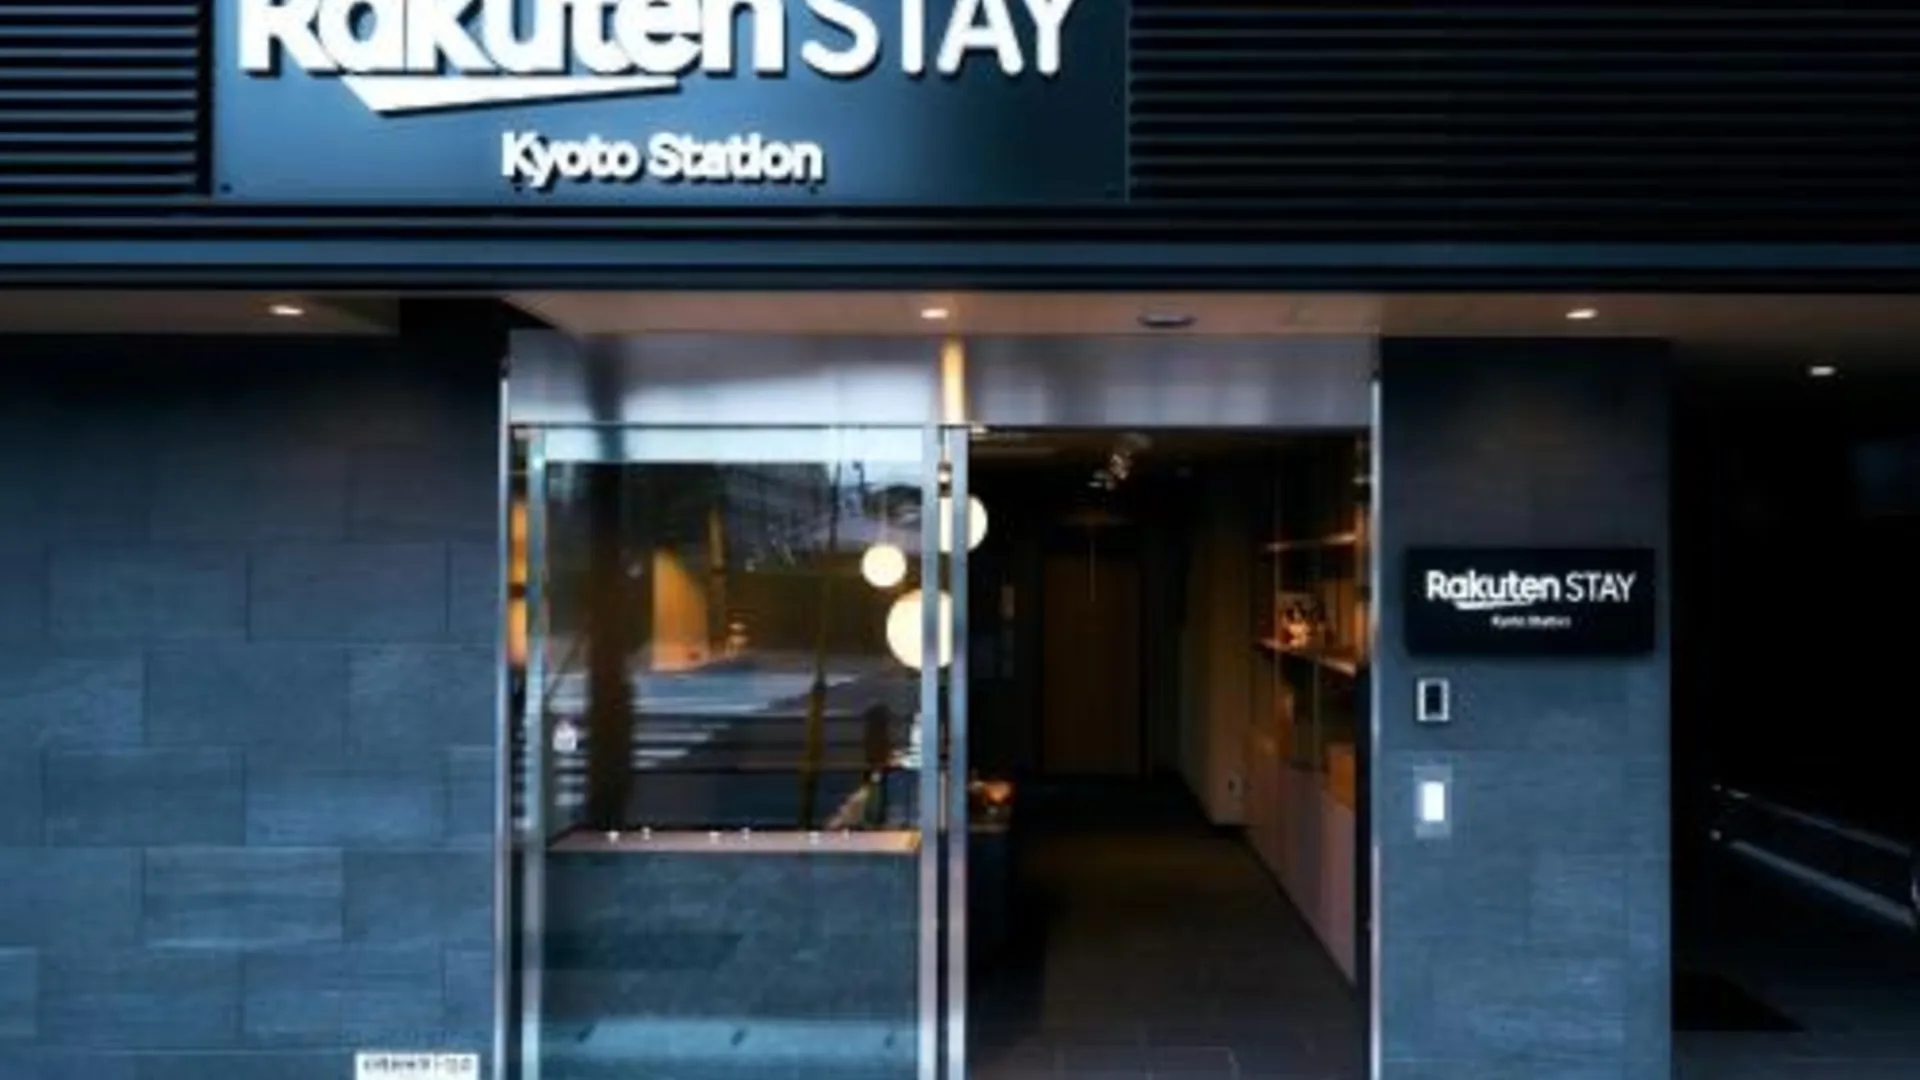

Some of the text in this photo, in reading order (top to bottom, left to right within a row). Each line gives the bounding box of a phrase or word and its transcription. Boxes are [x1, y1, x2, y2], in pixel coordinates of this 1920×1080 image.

[238, 0, 784, 72] Rakuten
[501, 131, 823, 187] Kyoto Station
[1426, 568, 1637, 603] Rakuten STAY
